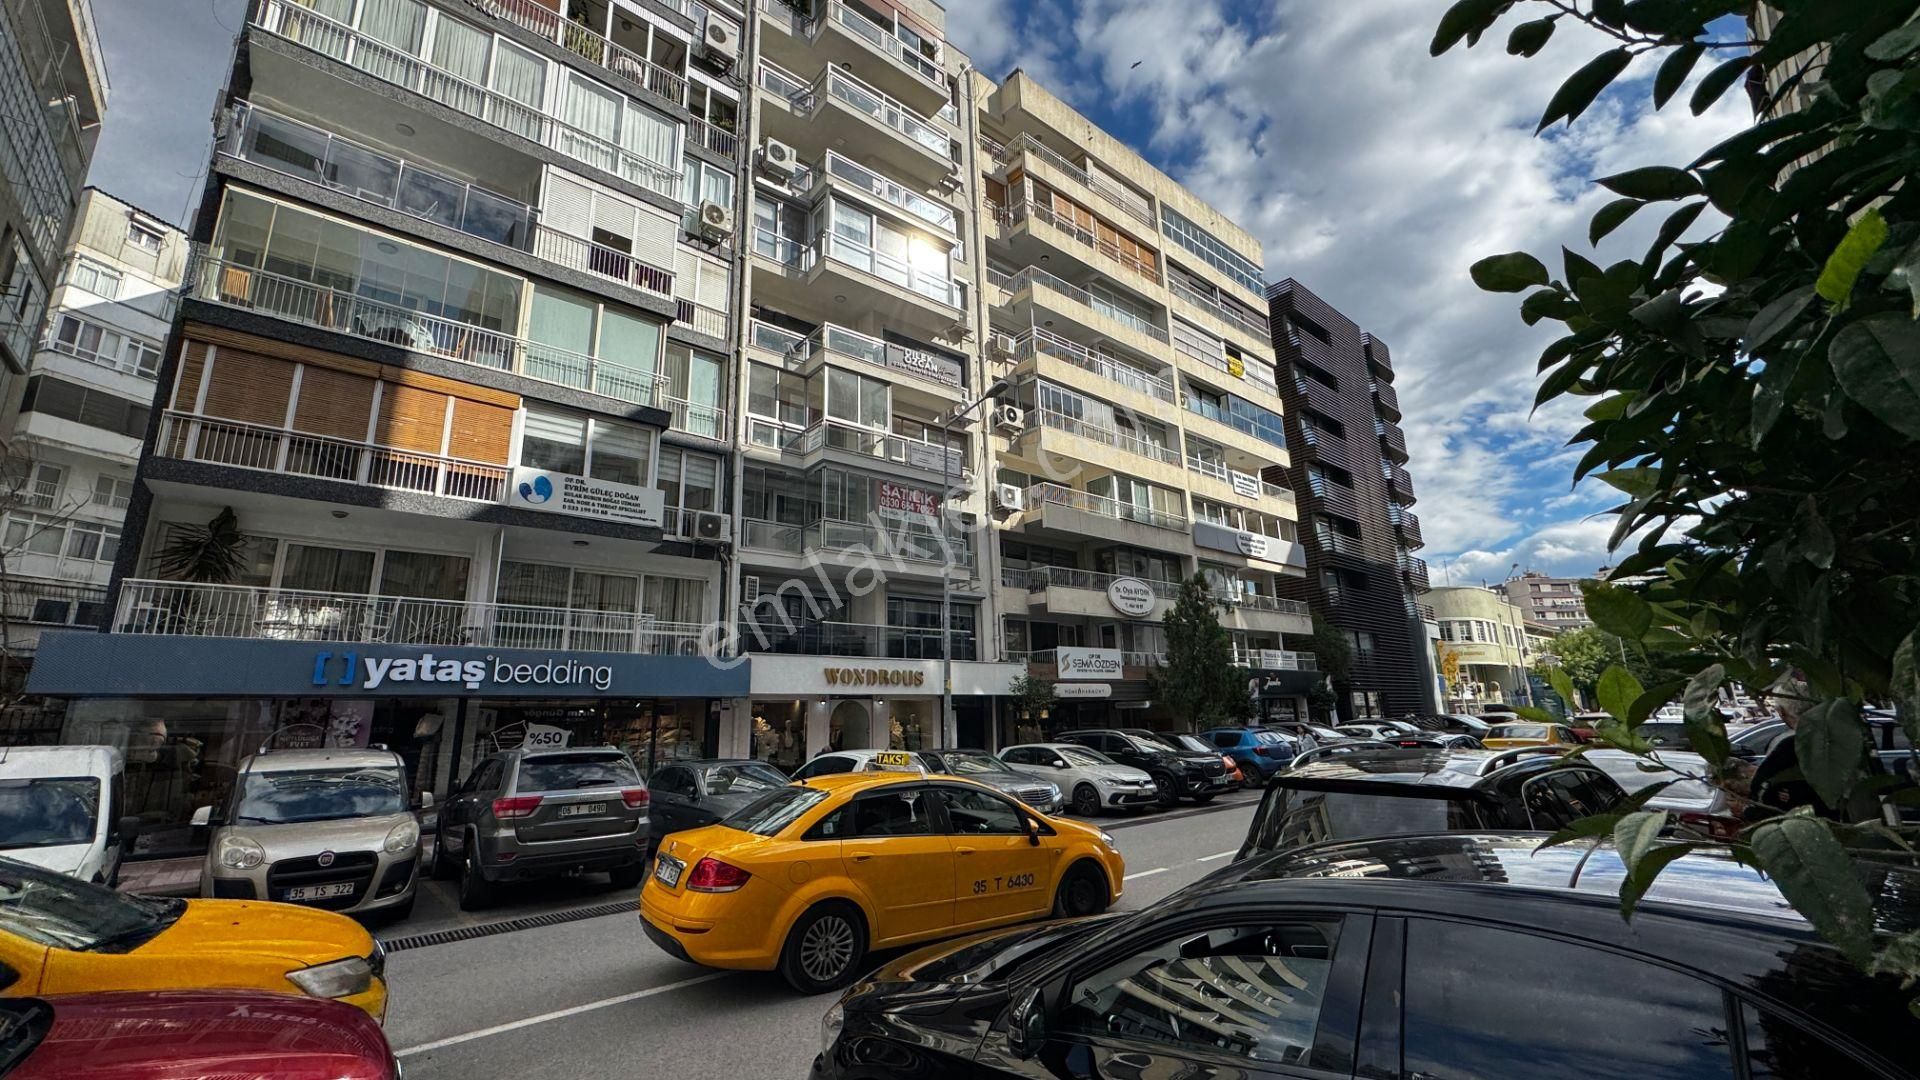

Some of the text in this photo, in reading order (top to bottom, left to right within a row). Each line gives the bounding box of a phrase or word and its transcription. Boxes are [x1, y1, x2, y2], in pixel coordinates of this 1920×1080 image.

[614, 490, 640, 502] DOĞAN
[1072, 658, 1094, 668] SEMA
[363, 654, 612, 690] yataş bedding
[824, 668, 925, 687] WONDROUS
[529, 732, 562, 745] %50
[973, 873, 1034, 894] 35 T 6430
[291, 884, 353, 899] 35 TS 322
